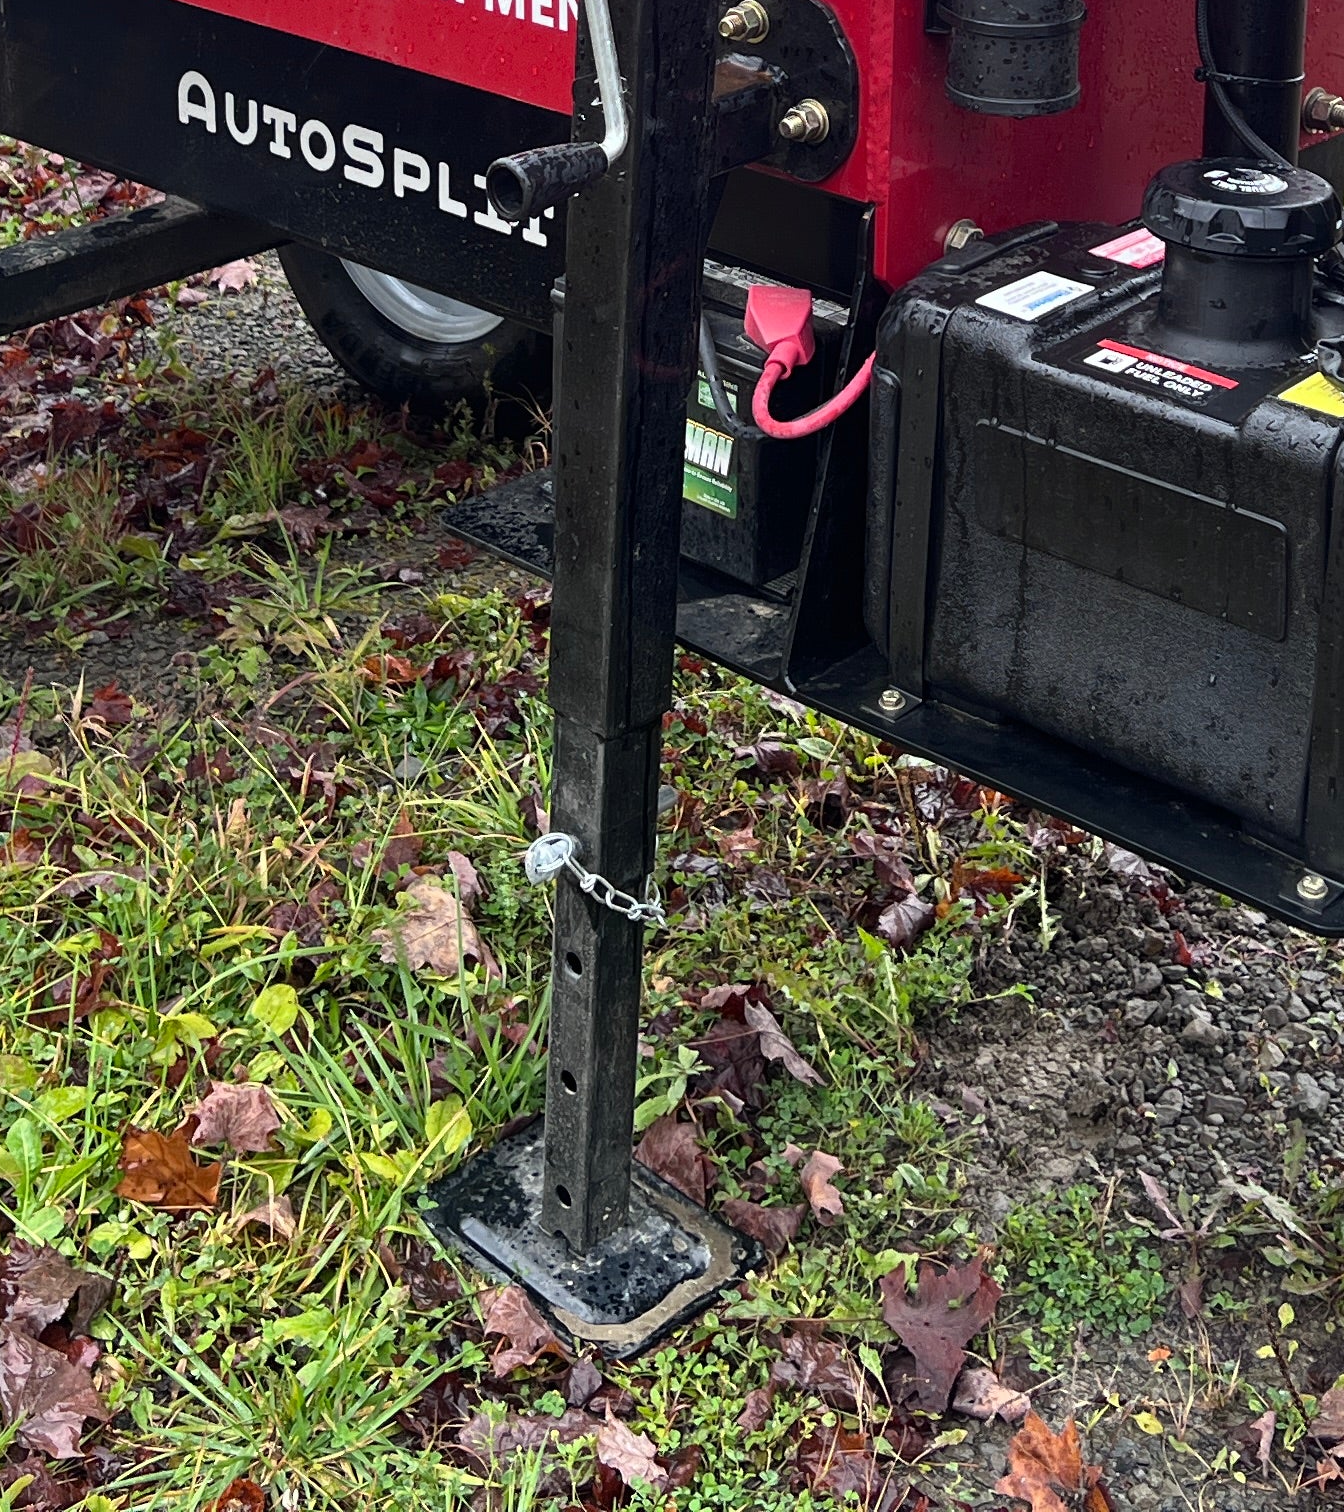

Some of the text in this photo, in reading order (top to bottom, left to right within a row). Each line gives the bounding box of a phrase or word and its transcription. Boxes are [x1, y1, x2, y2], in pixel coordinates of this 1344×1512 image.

[1124, 367, 1206, 397] FUEL ONLY
[1135, 361, 1213, 392] UNLEADED
